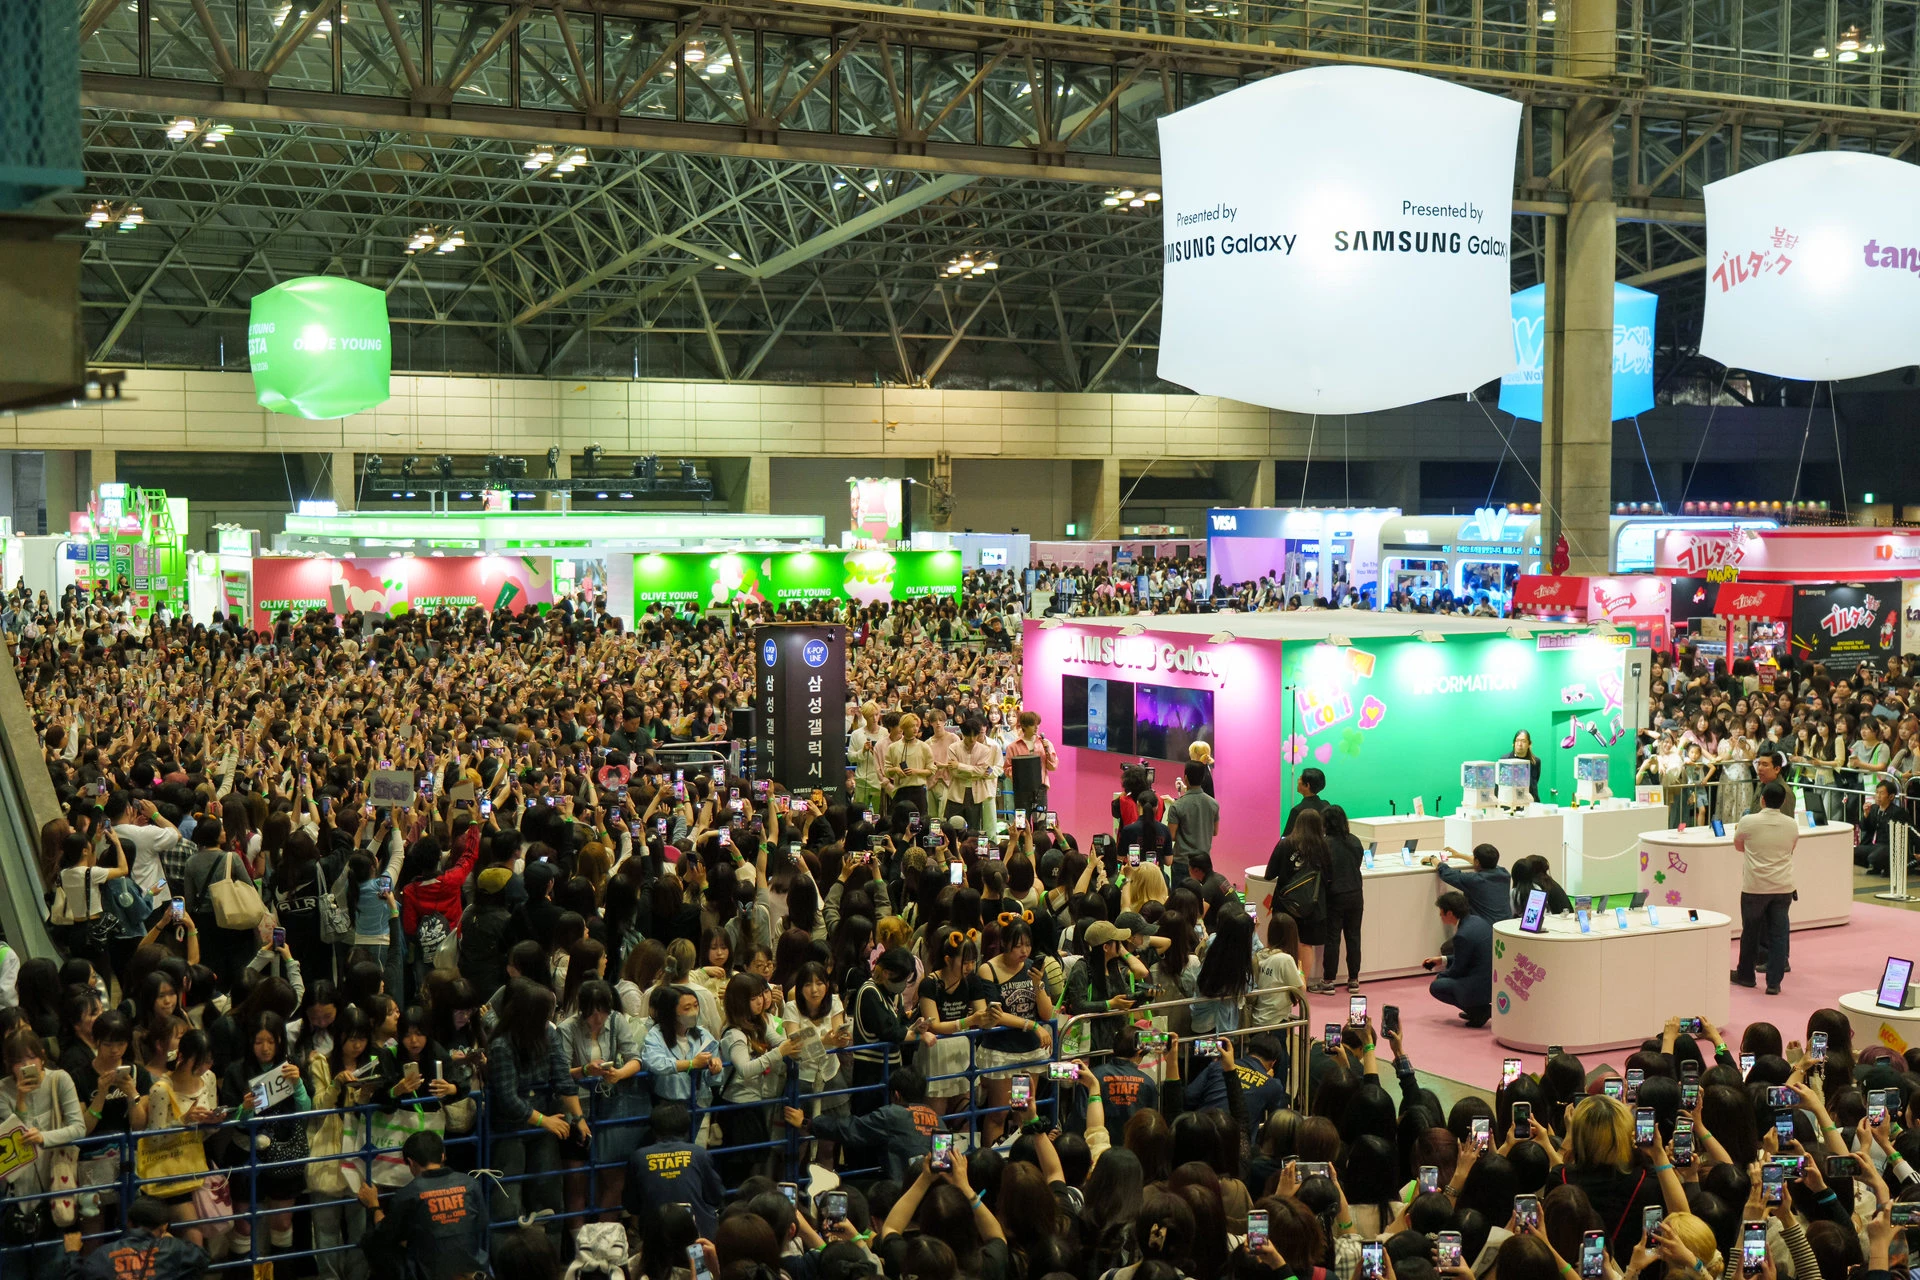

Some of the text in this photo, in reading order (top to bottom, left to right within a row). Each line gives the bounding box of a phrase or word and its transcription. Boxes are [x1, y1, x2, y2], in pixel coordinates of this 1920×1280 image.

[1177, 203, 1237, 227] Presented by
[1403, 201, 1483, 224] Presented by
[1335, 231, 1461, 253] SAMSUNG
[1770, 226, 1799, 250] 불닭
[1165, 234, 1297, 264] MSUNG Galaxy
[1712, 250, 1792, 292] ブルダック
[341, 338, 382, 351] YOUNG
[1614, 326, 1652, 347] ラベル
[1211, 515, 1236, 530] VISA
[1676, 537, 1746, 573] ブルダック
[1706, 565, 1738, 583] MART
[641, 591, 698, 600] OLIVE YOUNG
[777, 588, 831, 597] OLIVE YOUNG
[906, 585, 956, 594] OLIVE YOUNG
[260, 599, 327, 609] OLIVE YOUNG
[413, 596, 477, 605] OLIVE YOUNG
[1821, 604, 1876, 636] ブルダック
[807, 646, 824, 655] K-POP
[807, 675, 823, 778] 삼성갤럭시
[277, 898, 317, 911] AIR
[1236, 1071, 1266, 1088] TAFF
[1108, 1083, 1140, 1095] STAFF
[648, 1156, 691, 1171] STAFF
[428, 1194, 465, 1213] STAFF
